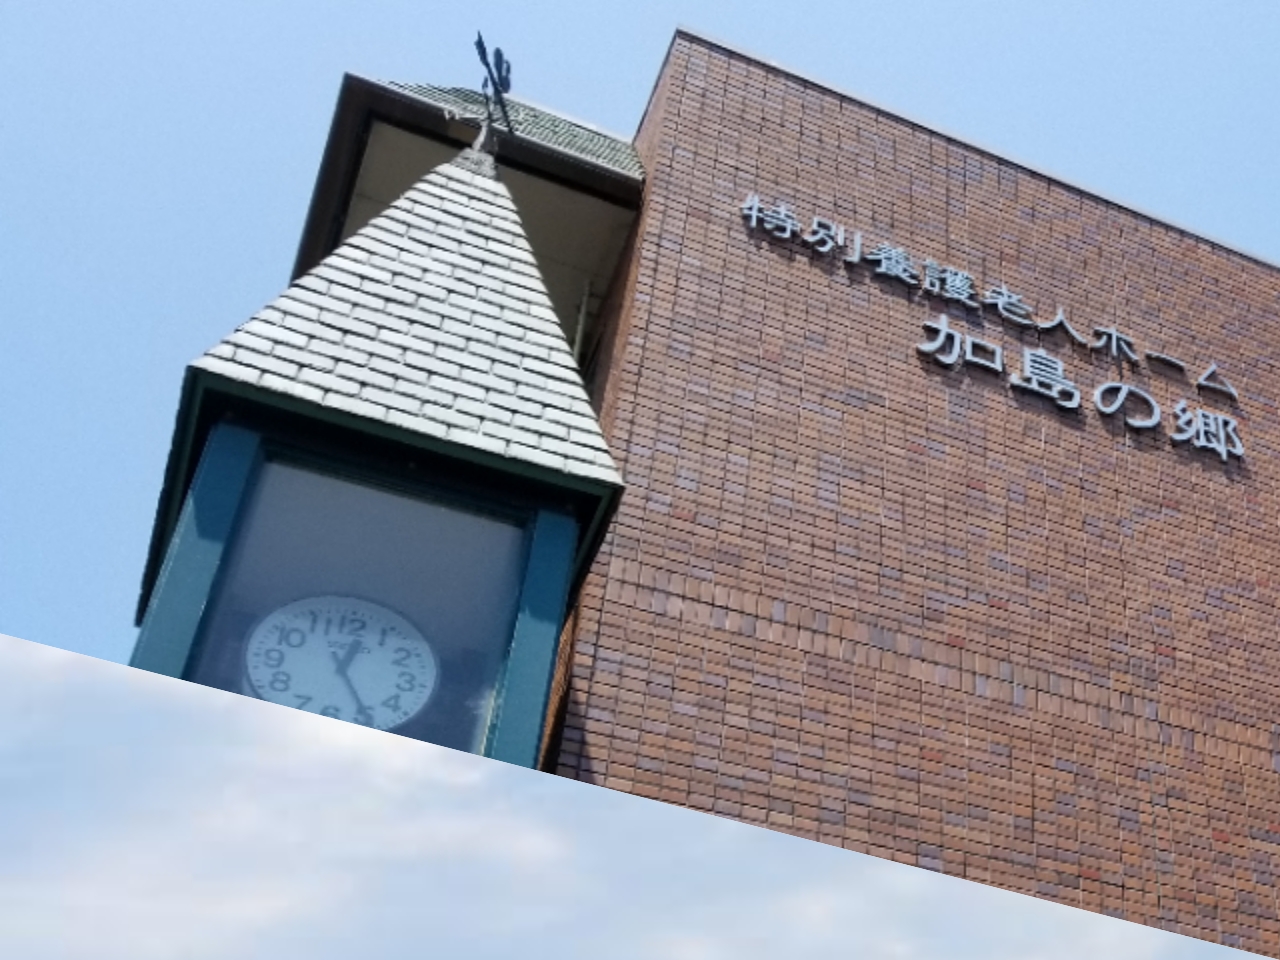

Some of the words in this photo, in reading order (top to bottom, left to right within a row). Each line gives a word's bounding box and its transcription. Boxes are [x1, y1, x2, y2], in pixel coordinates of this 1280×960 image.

[741, 193, 1239, 401] 特別養護老人ホーム
[917, 313, 1245, 461] 加島の郷
[277, 623, 307, 648] 10
[337, 614, 367, 637] 12
[377, 627, 388, 647] 1
[263, 648, 285, 669] 9
[391, 647, 412, 669] 2
[268, 671, 292, 693] 8
[395, 671, 417, 693] 3
[380, 693, 402, 713] 4
